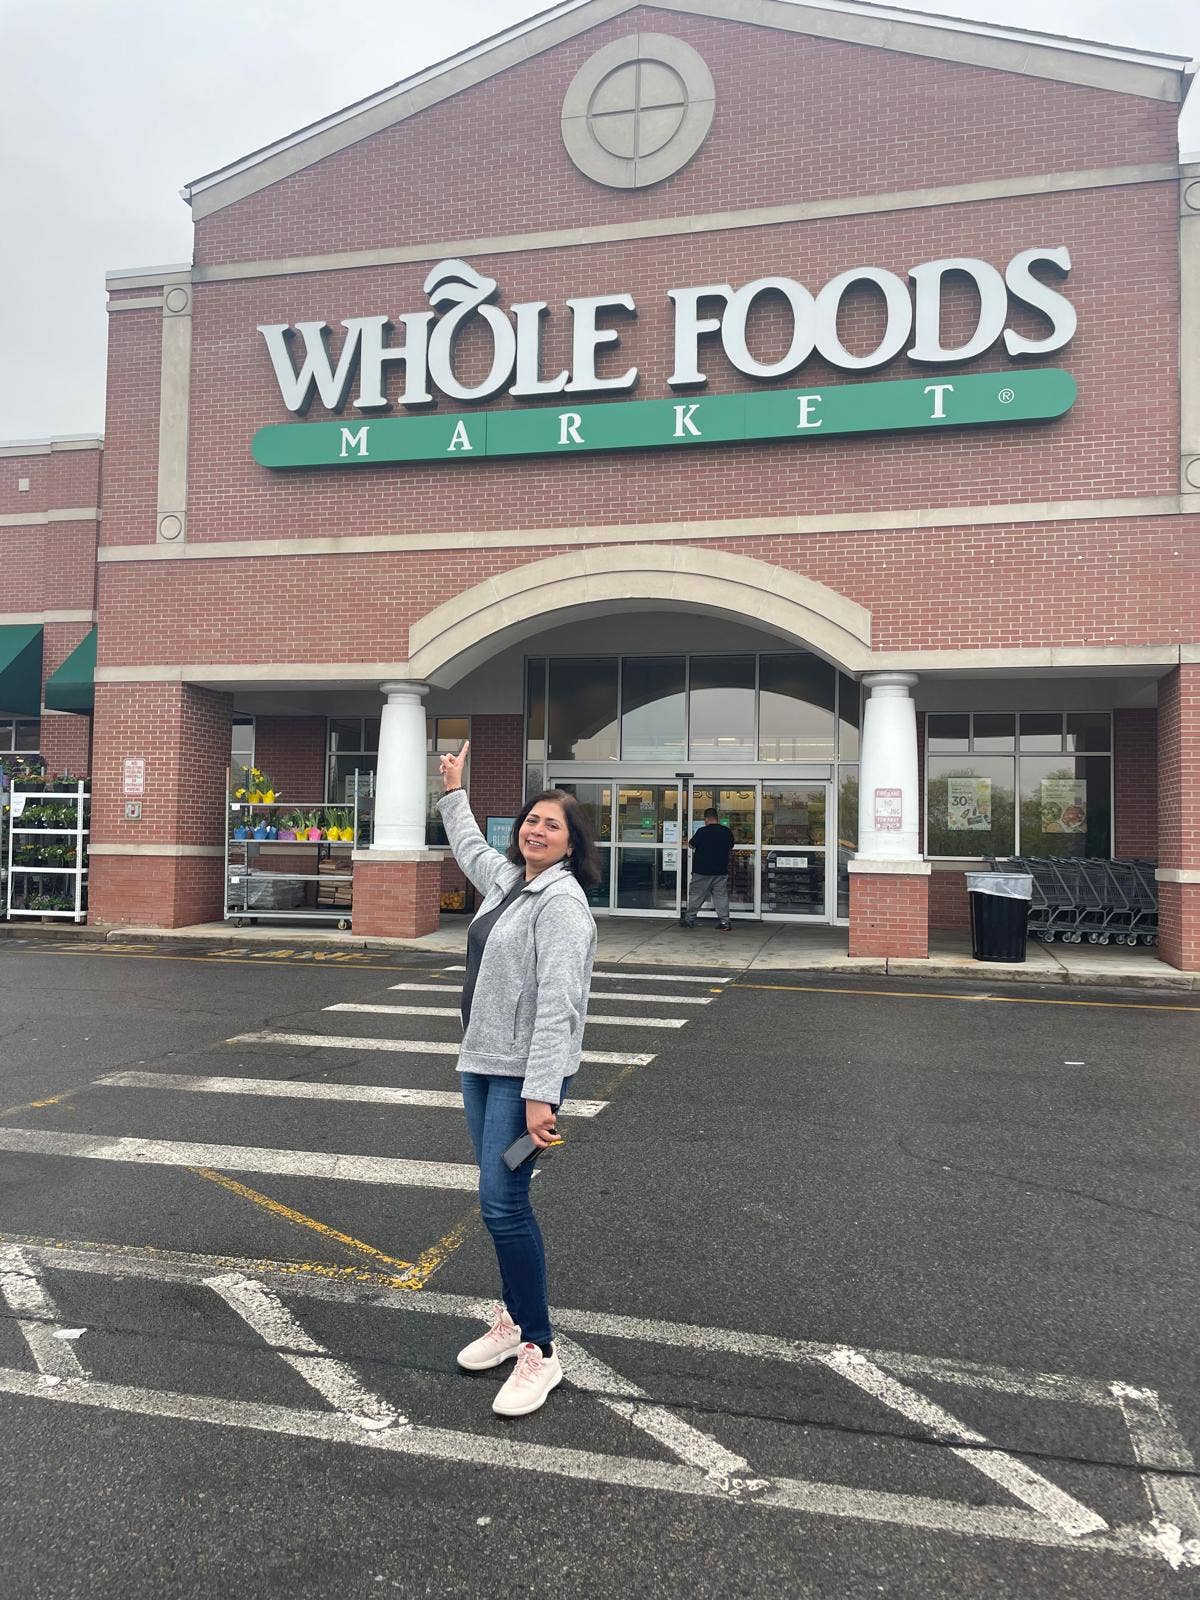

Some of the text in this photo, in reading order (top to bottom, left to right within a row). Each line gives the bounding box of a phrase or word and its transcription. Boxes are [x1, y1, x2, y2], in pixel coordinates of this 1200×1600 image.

[257, 246, 1077, 412] WHOLE FOODS
[339, 384, 955, 457] MARKET
